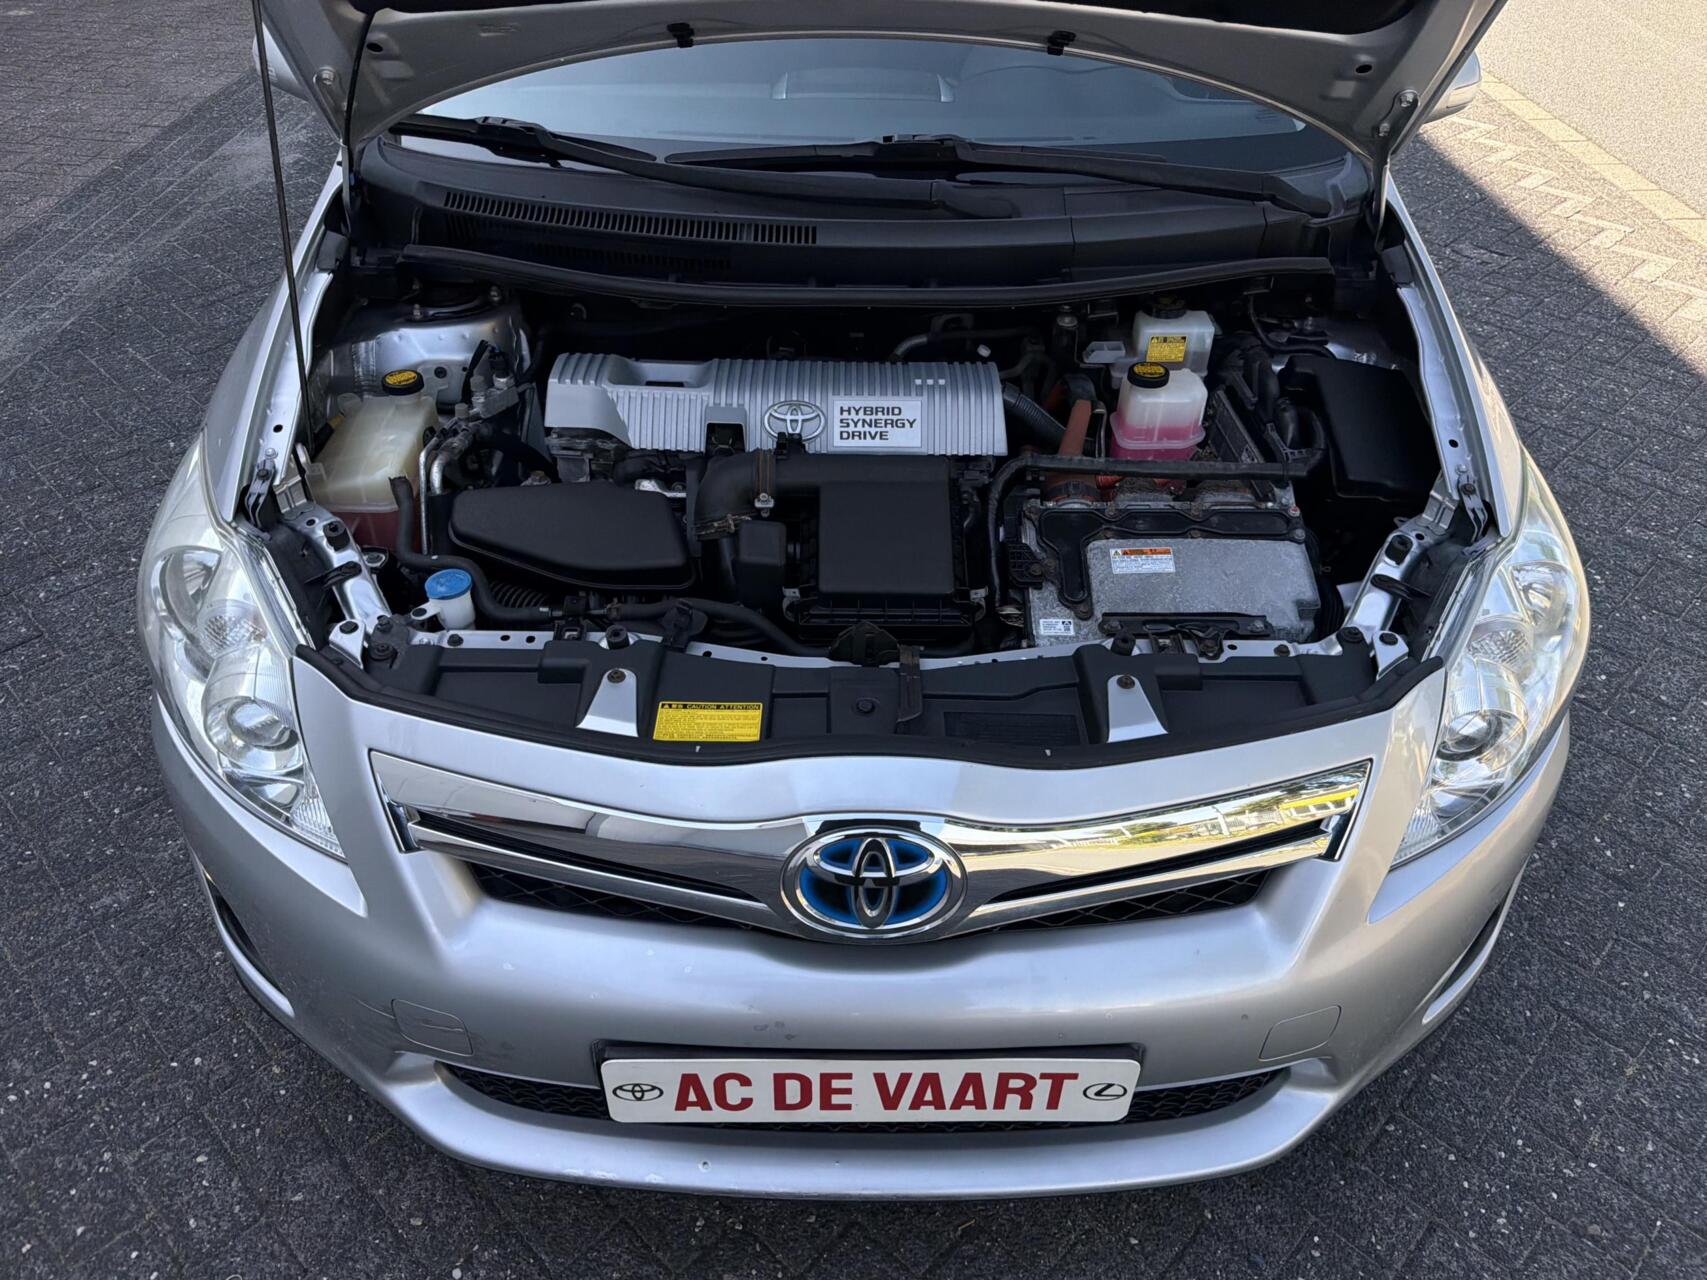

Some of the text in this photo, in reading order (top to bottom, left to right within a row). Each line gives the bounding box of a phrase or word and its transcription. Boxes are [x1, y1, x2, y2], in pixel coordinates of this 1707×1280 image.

[840, 406, 902, 416] HYBRID
[840, 418, 917, 428] SYNERGY
[840, 431, 889, 440] DRIVE
[674, 1072, 1079, 1112] AC DE VAART
